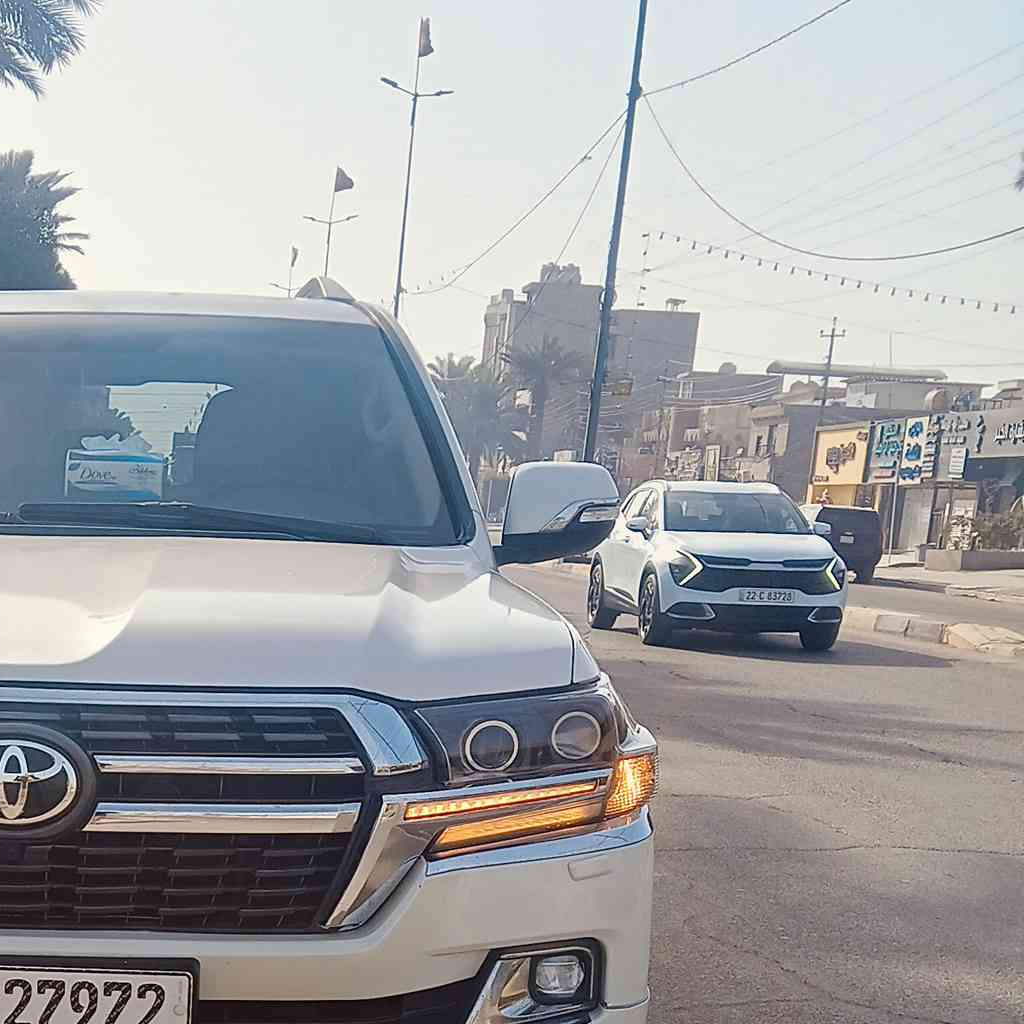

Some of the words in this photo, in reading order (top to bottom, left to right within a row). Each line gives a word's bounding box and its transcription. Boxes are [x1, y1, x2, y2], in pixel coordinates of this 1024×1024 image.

[80, 466, 112, 480] Dove
[745, 591, 756, 601] 22
[759, 591, 765, 600] C
